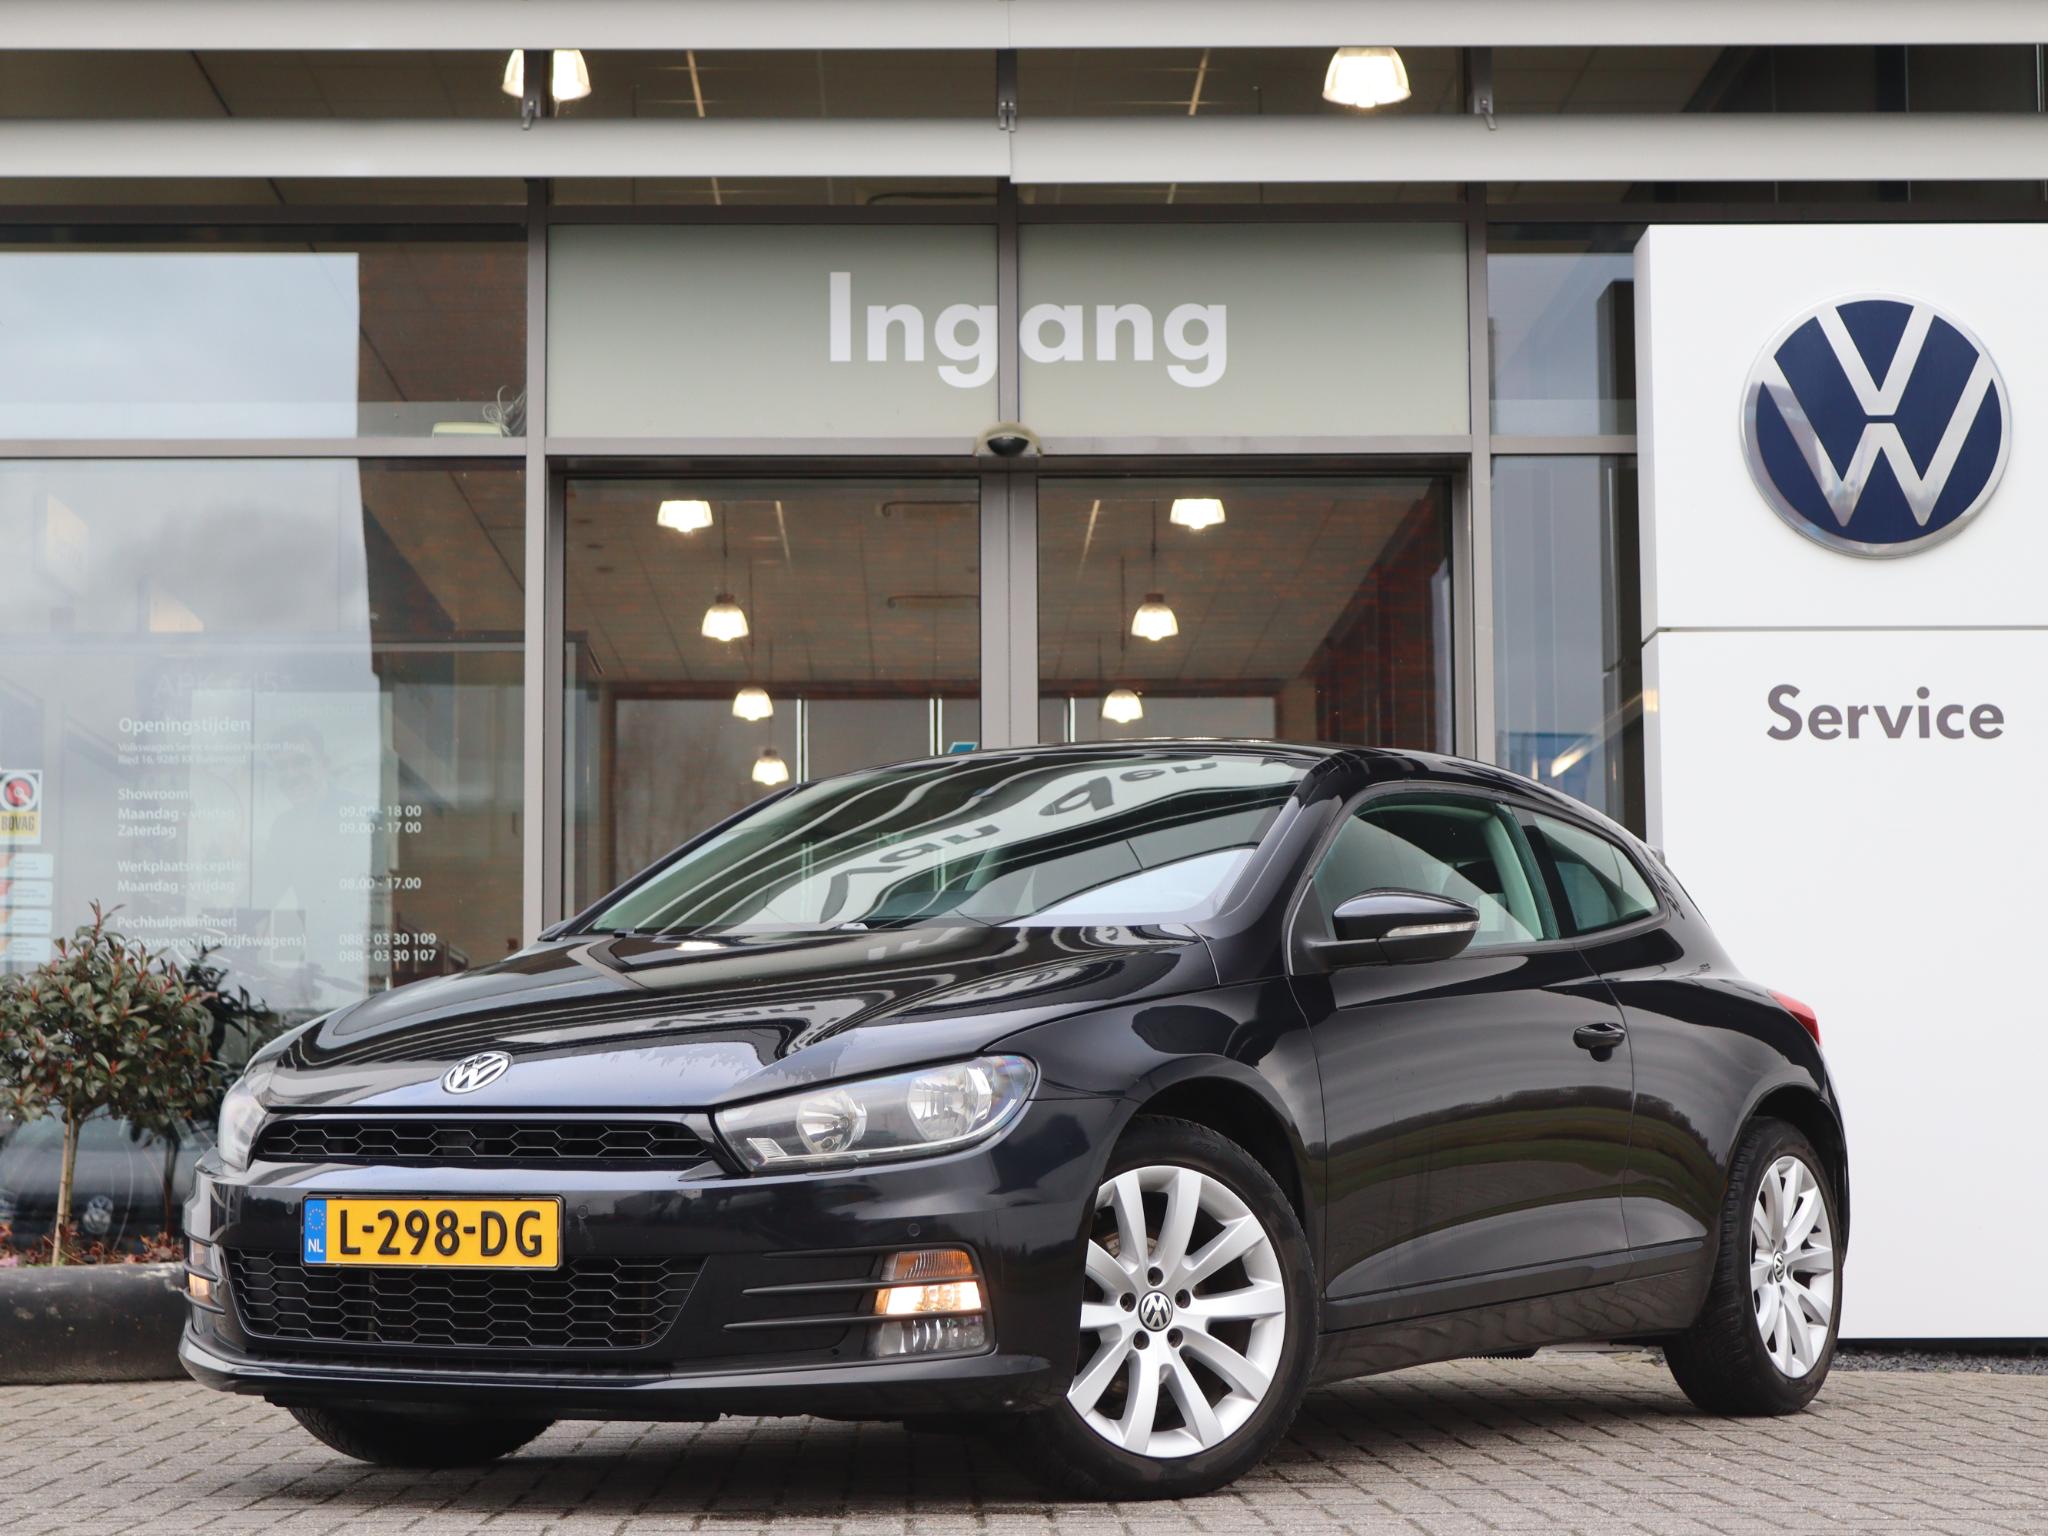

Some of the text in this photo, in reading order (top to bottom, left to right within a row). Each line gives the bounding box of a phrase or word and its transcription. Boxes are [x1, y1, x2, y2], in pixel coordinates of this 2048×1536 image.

[830, 272, 1227, 388] Ingang
[1766, 683, 2005, 742] Service
[118, 716, 251, 738] Openingstijden
[0, 815, 35, 832] BOVAG
[118, 807, 179, 823] Maandag
[118, 824, 177, 839] Zaterdag
[118, 880, 179, 896] Maandag
[386, 877, 422, 890] 17.00
[374, 933, 391, 946] 03
[393, 933, 410, 946] 30
[413, 933, 437, 946] 109
[374, 949, 391, 962] 03
[393, 949, 410, 962] 30
[413, 949, 437, 962] 107
[307, 1208, 543, 1258] NL L-298-DG
